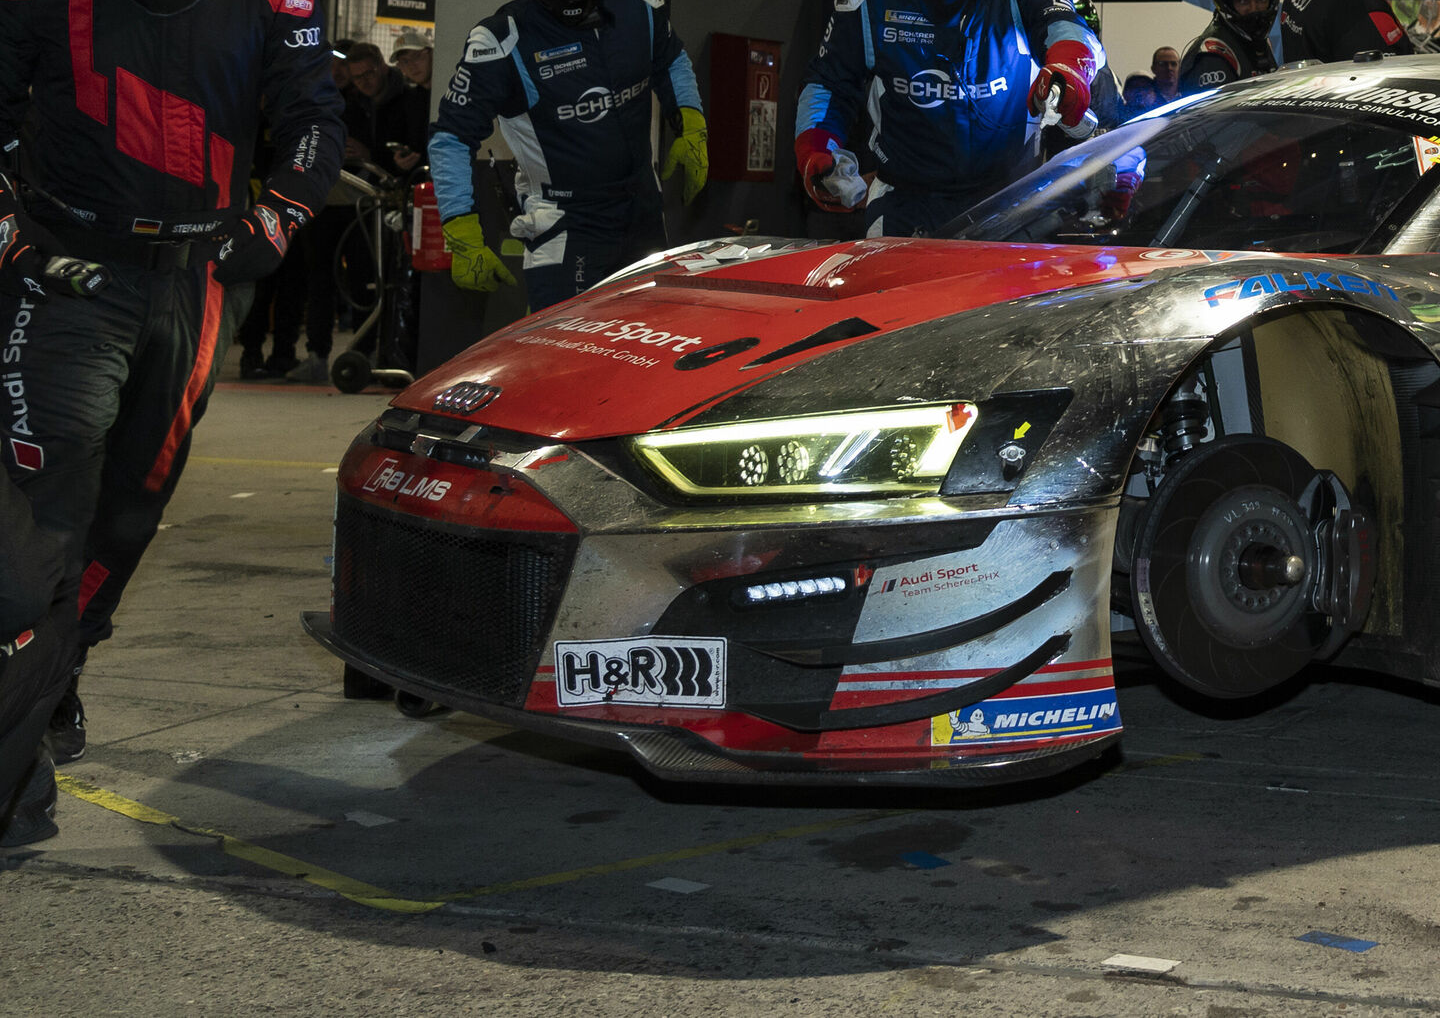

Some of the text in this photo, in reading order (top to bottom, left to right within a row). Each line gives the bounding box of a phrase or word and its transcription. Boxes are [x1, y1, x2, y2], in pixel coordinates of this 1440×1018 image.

[553, 57, 587, 70] SCHERER
[556, 77, 650, 121] SCHERER
[893, 76, 1009, 101] SCHERER
[1237, 100, 1262, 108] THE
[1263, 100, 1298, 108] REAL
[1299, 100, 1358, 111] DRIVING
[172, 222, 208, 235] STEFAN
[576, 255, 586, 283] PHX
[1204, 271, 1400, 308] FALKEN
[545, 316, 702, 353] Audi Sport
[556, 338, 661, 368] Audi Sport GmbH
[2, 371, 35, 436] Audi
[399, 474, 452, 501] LMS
[899, 562, 979, 588] Audi Sport
[901, 570, 1000, 598] Team Scherer PHX
[565, 649, 657, 691] H&R
[994, 703, 1117, 729] MICHELIN
